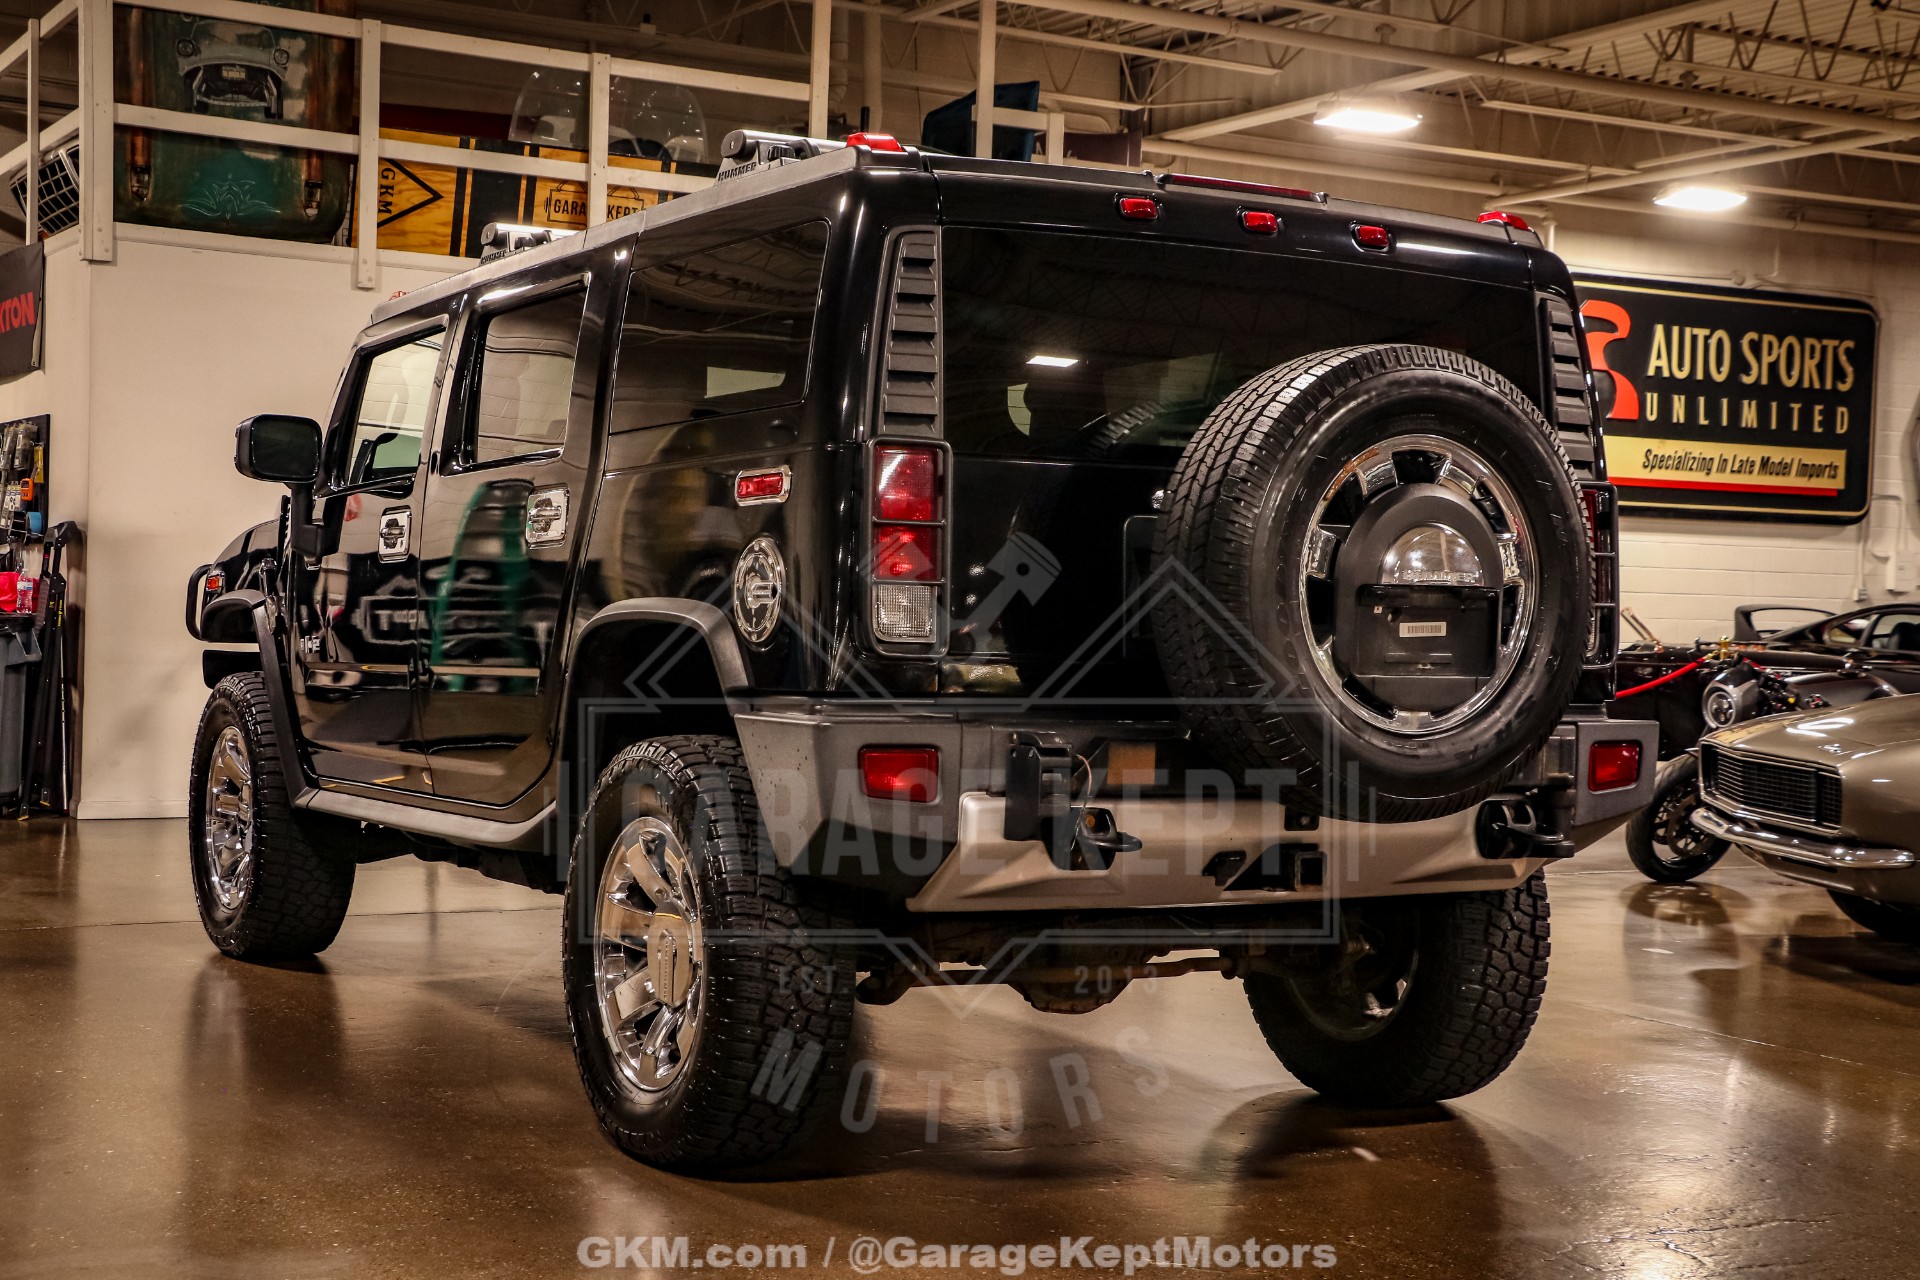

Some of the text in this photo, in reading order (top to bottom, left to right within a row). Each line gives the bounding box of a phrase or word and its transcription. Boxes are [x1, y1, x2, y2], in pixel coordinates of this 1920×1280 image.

[718, 162, 757, 181] HUMMER
[378, 167, 396, 215] GKM
[553, 199, 586, 216] GARA
[1647, 324, 1855, 391] AUTO SPORTS
[1645, 391, 1849, 434] UNLIMITED
[1642, 448, 1840, 482] Specializing In Late Model Imports
